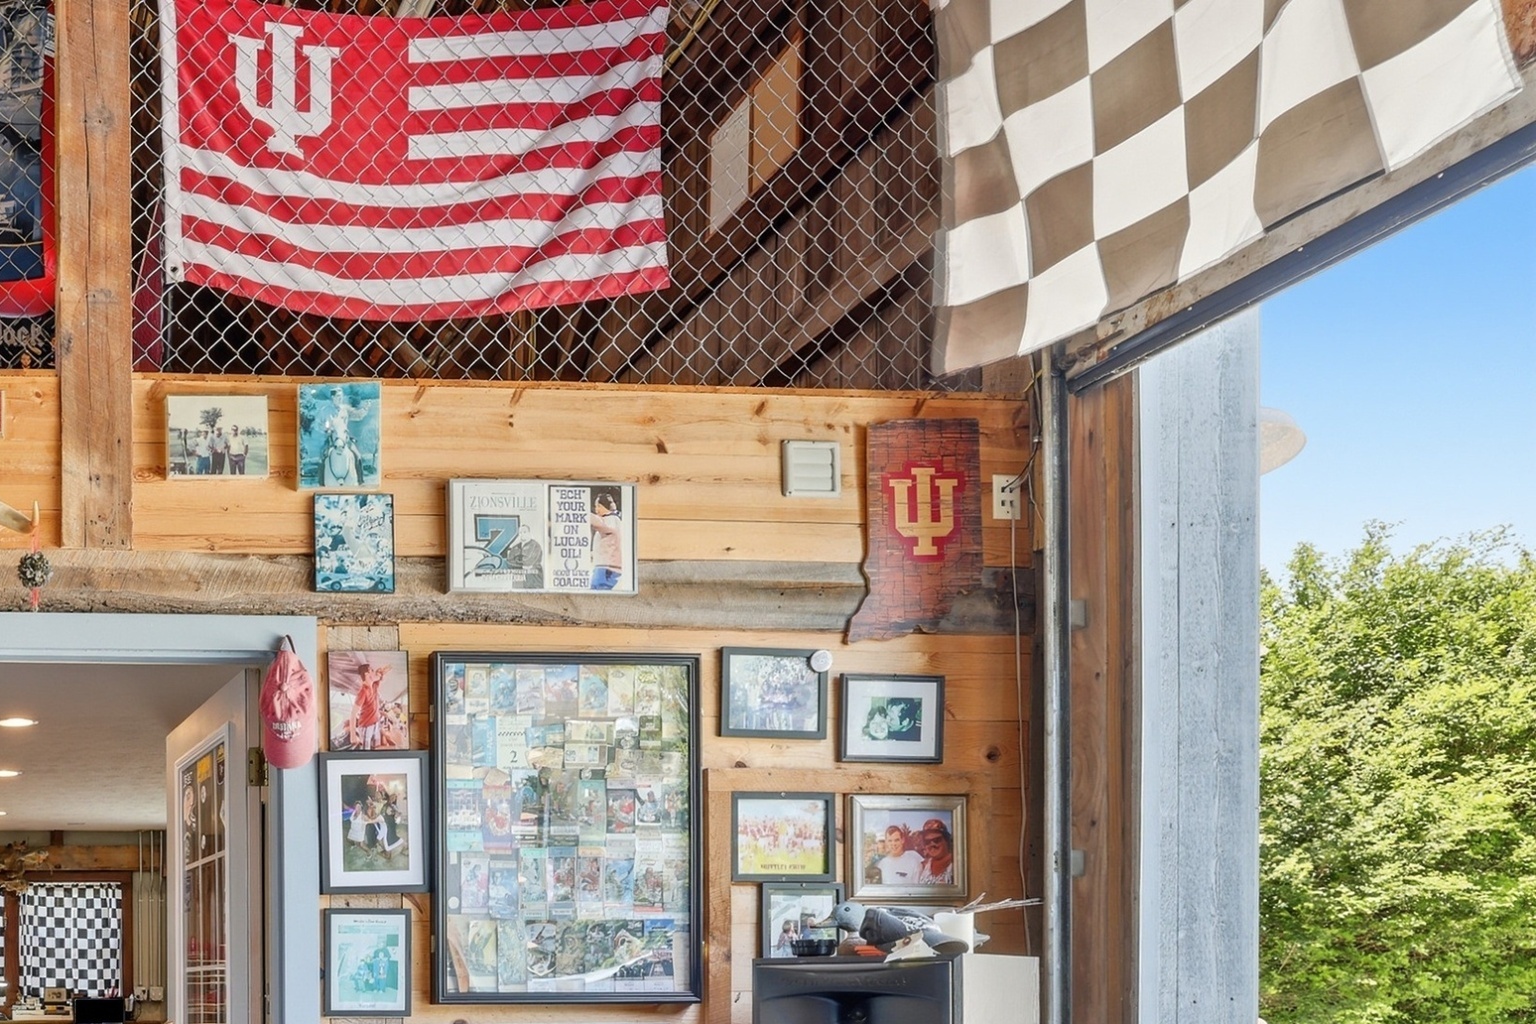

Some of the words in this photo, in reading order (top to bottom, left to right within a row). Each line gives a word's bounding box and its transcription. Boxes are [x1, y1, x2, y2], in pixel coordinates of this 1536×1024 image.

[470, 496, 537, 508] ZIONSVILLE
[557, 502, 585, 511] YOUR
[889, 467, 958, 555] IU
[556, 513, 587, 523] MARK
[564, 525, 579, 534] ON
[554, 537, 589, 547] LUCAS
